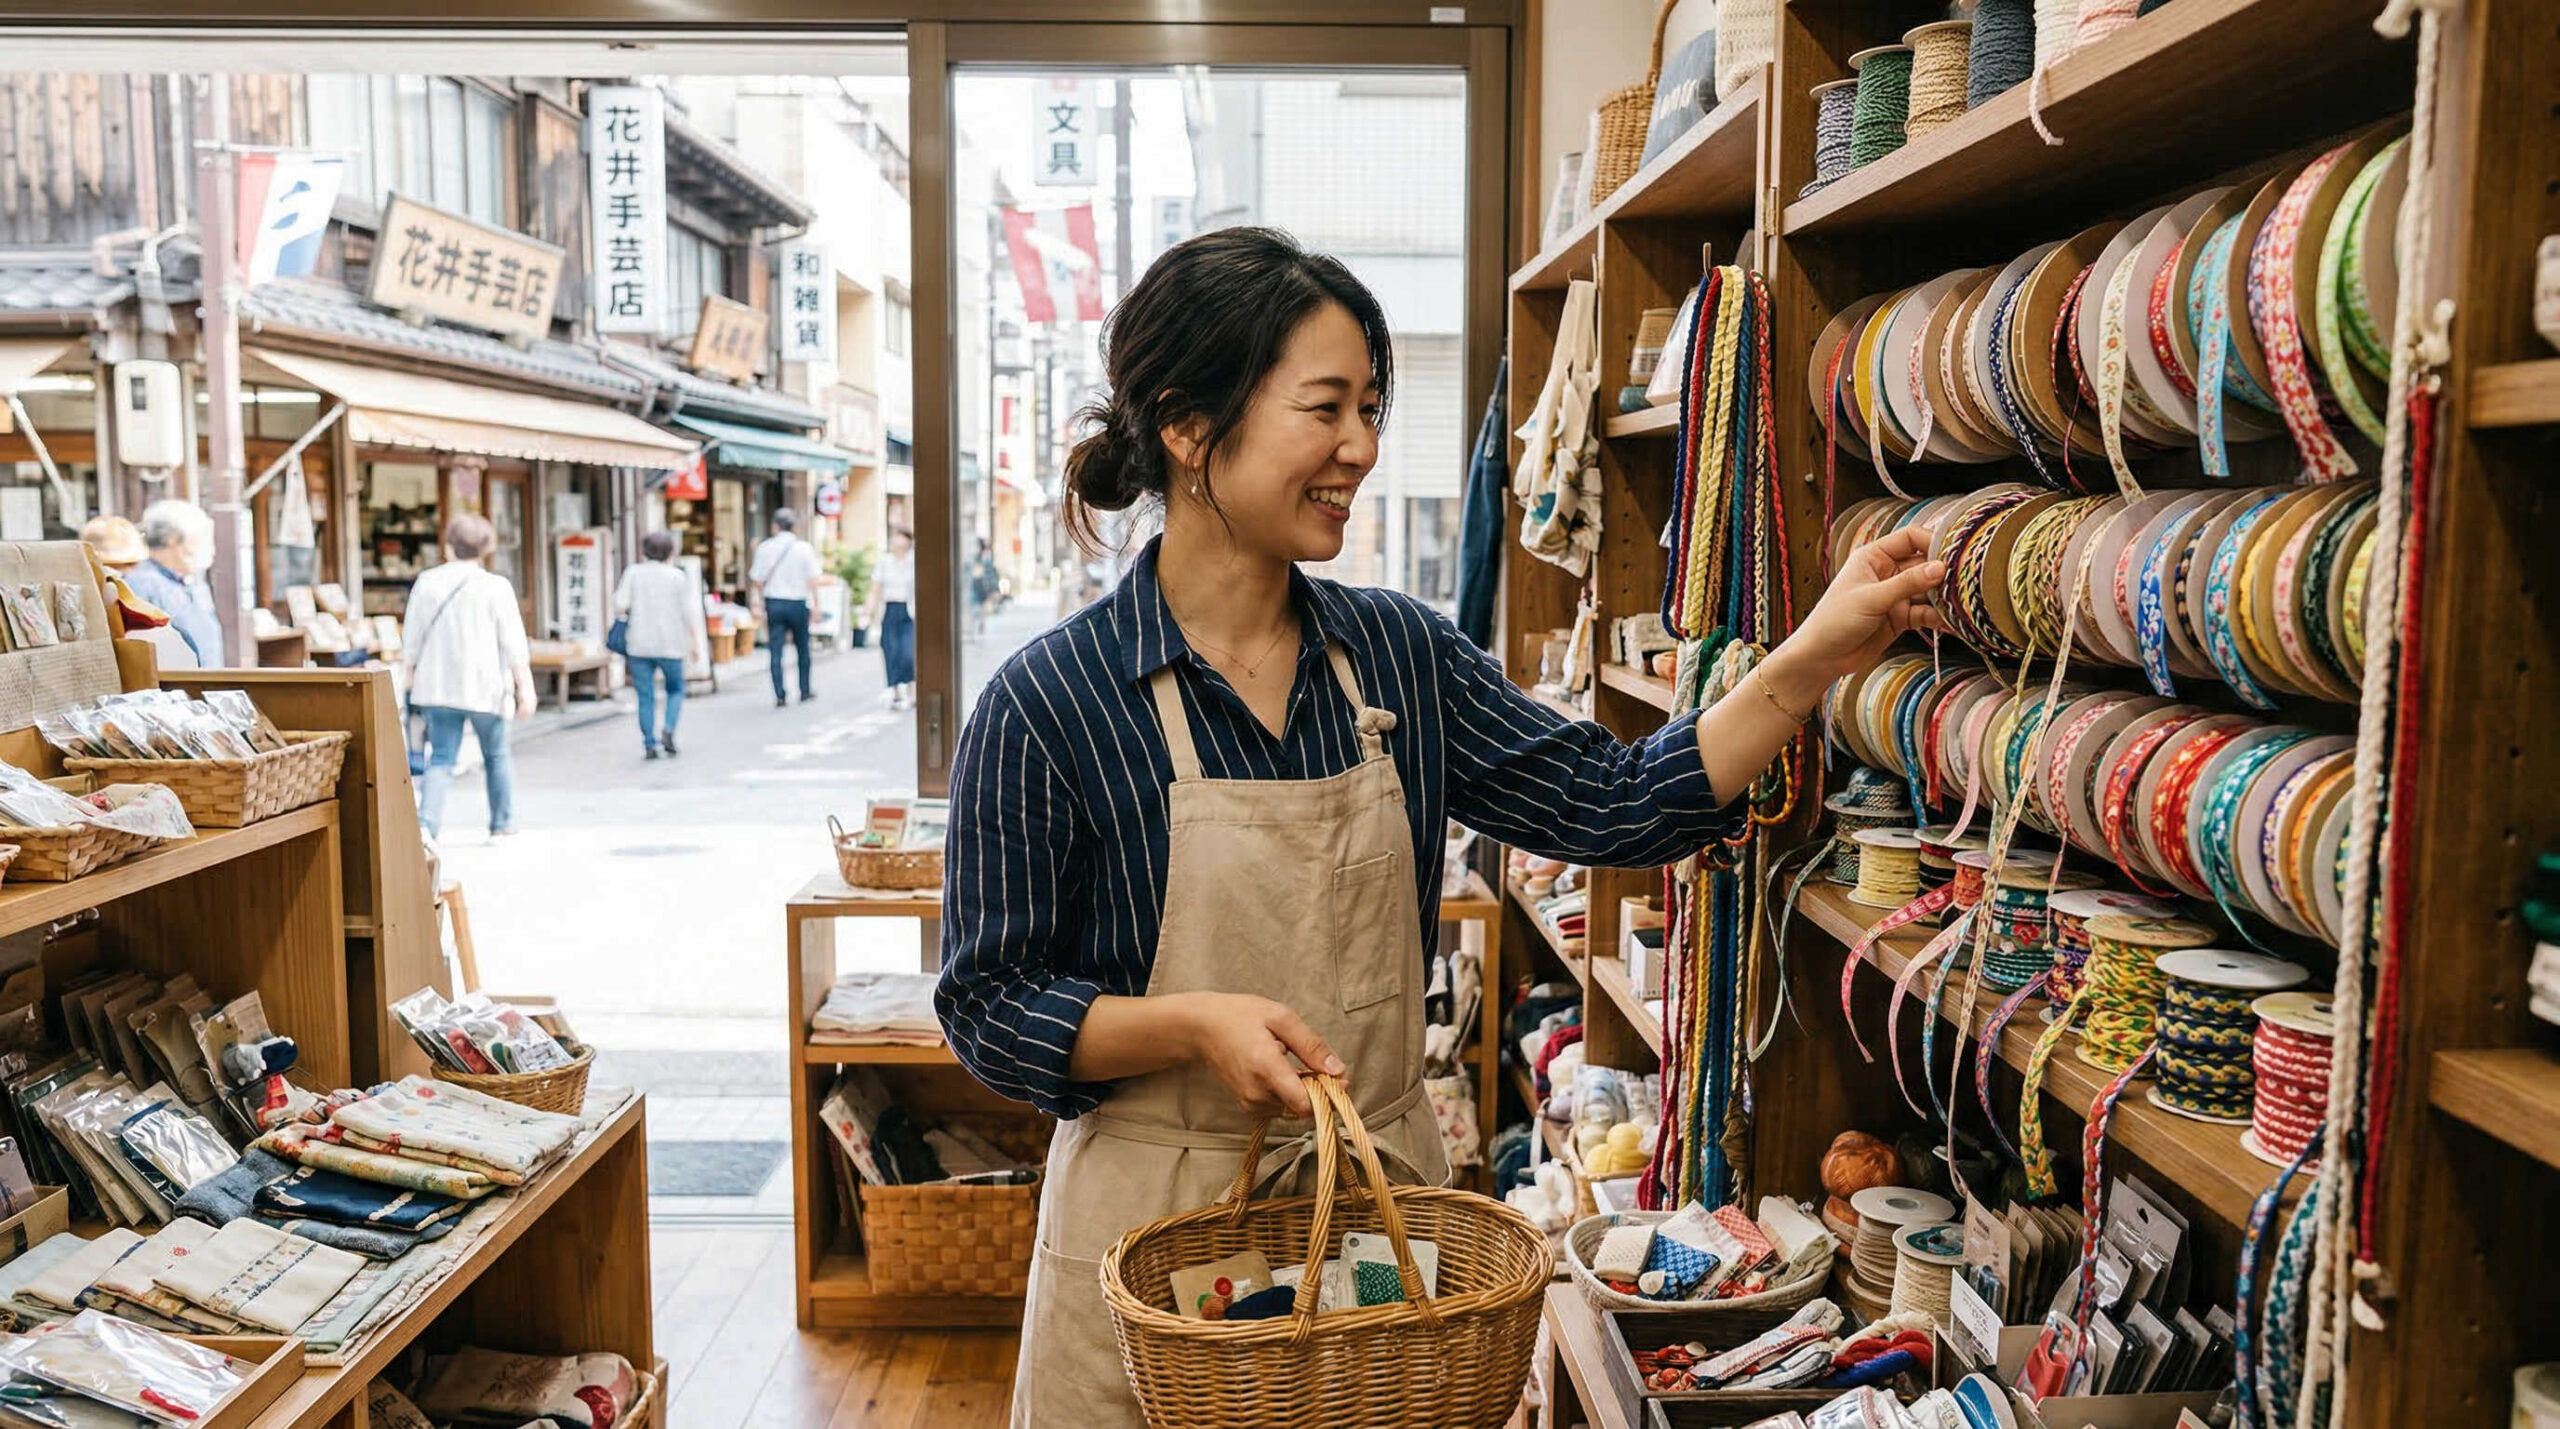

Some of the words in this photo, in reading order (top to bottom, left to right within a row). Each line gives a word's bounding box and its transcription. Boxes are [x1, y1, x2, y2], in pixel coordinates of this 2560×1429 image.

[1047, 99, 1082, 174] 文具
[605, 104, 643, 316] 花井手芸店
[399, 223, 548, 317] 花井手芸店
[792, 252, 819, 348] 和雑貨
